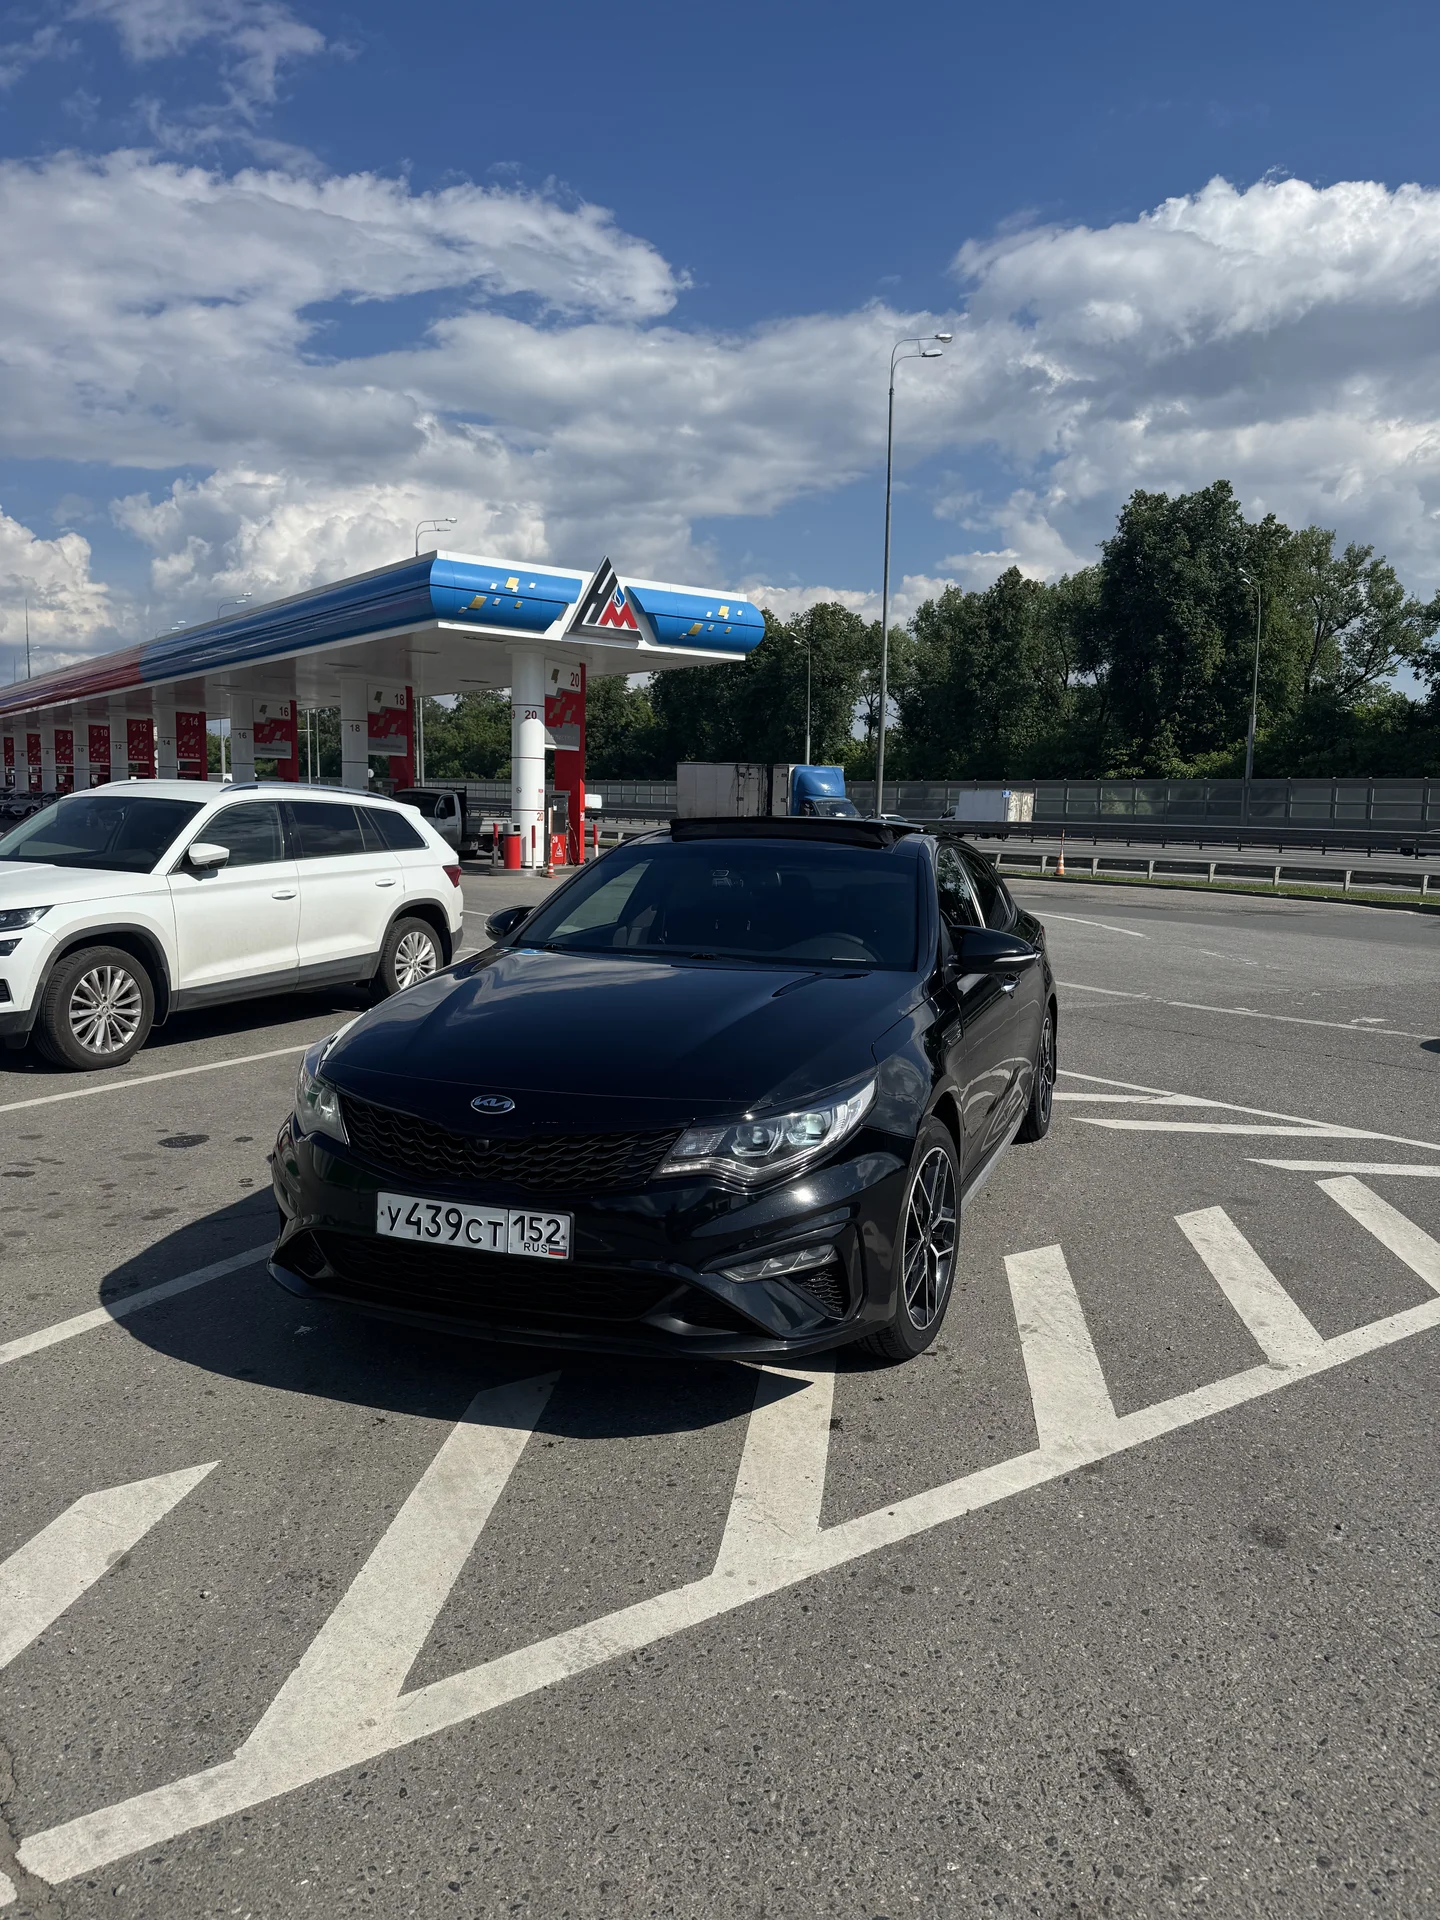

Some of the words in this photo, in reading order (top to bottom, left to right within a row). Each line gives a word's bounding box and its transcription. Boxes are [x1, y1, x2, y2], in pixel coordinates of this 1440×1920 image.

[570, 672, 580, 687] 20
[394, 694, 405, 706] 18
[279, 706, 289, 717] 16
[524, 710, 537, 720] 20
[189, 717, 199, 726] 14
[139, 723, 147, 732] 12
[349, 724, 361, 733] 18
[100, 729, 108, 737] 10
[536, 812, 544, 821] 20
[387, 1202, 504, 1247] У439СТ
[512, 1215, 562, 1245] 152
[523, 1243, 548, 1254] RUS
